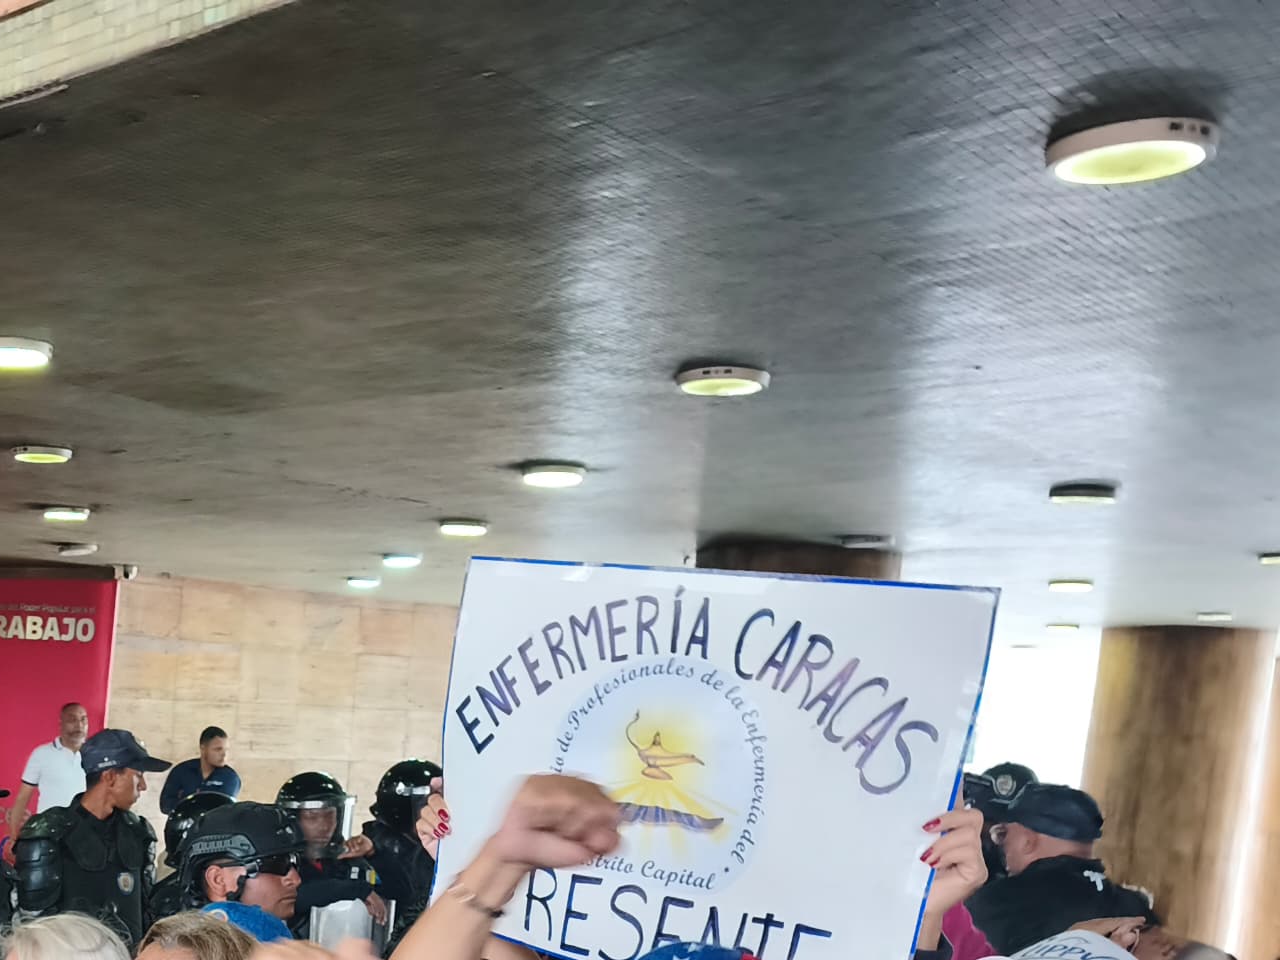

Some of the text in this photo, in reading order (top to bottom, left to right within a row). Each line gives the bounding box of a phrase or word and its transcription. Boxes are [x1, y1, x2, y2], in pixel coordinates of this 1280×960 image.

[456, 585, 939, 796] ENFERMERÍA CARACAS
[567, 657, 695, 731] Profesionales
[700, 669, 725, 692] de
[725, 686, 745, 710] la
[730, 828, 756, 865] del
[641, 860, 717, 891] Capital
